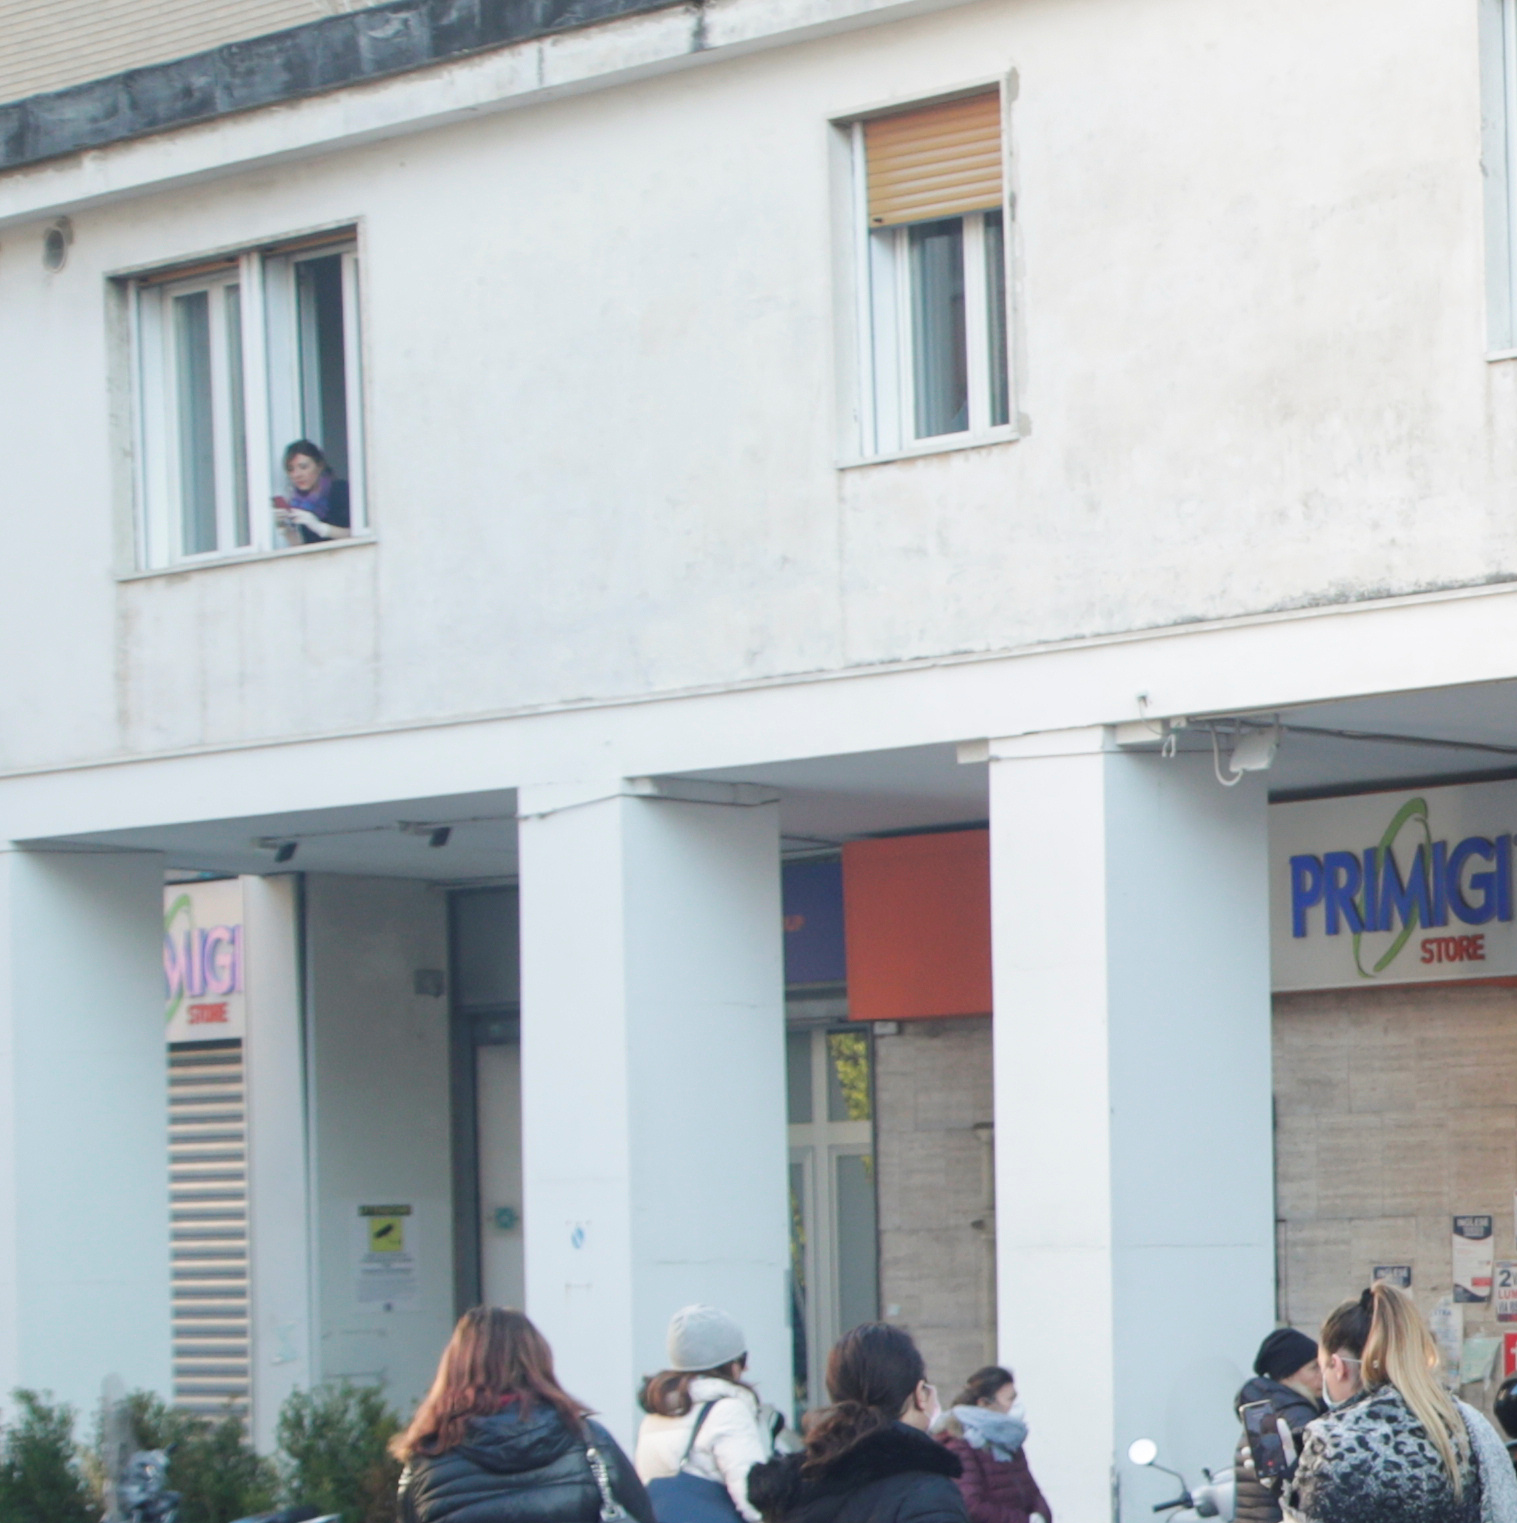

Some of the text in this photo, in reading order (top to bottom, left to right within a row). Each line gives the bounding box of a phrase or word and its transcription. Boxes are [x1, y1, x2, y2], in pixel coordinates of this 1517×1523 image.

[1290, 833, 1513, 939] PRIMIGI
[1420, 933, 1486, 964] STORE
[188, 1002, 229, 1024] STORE
[1499, 1269, 1512, 1288] 2
